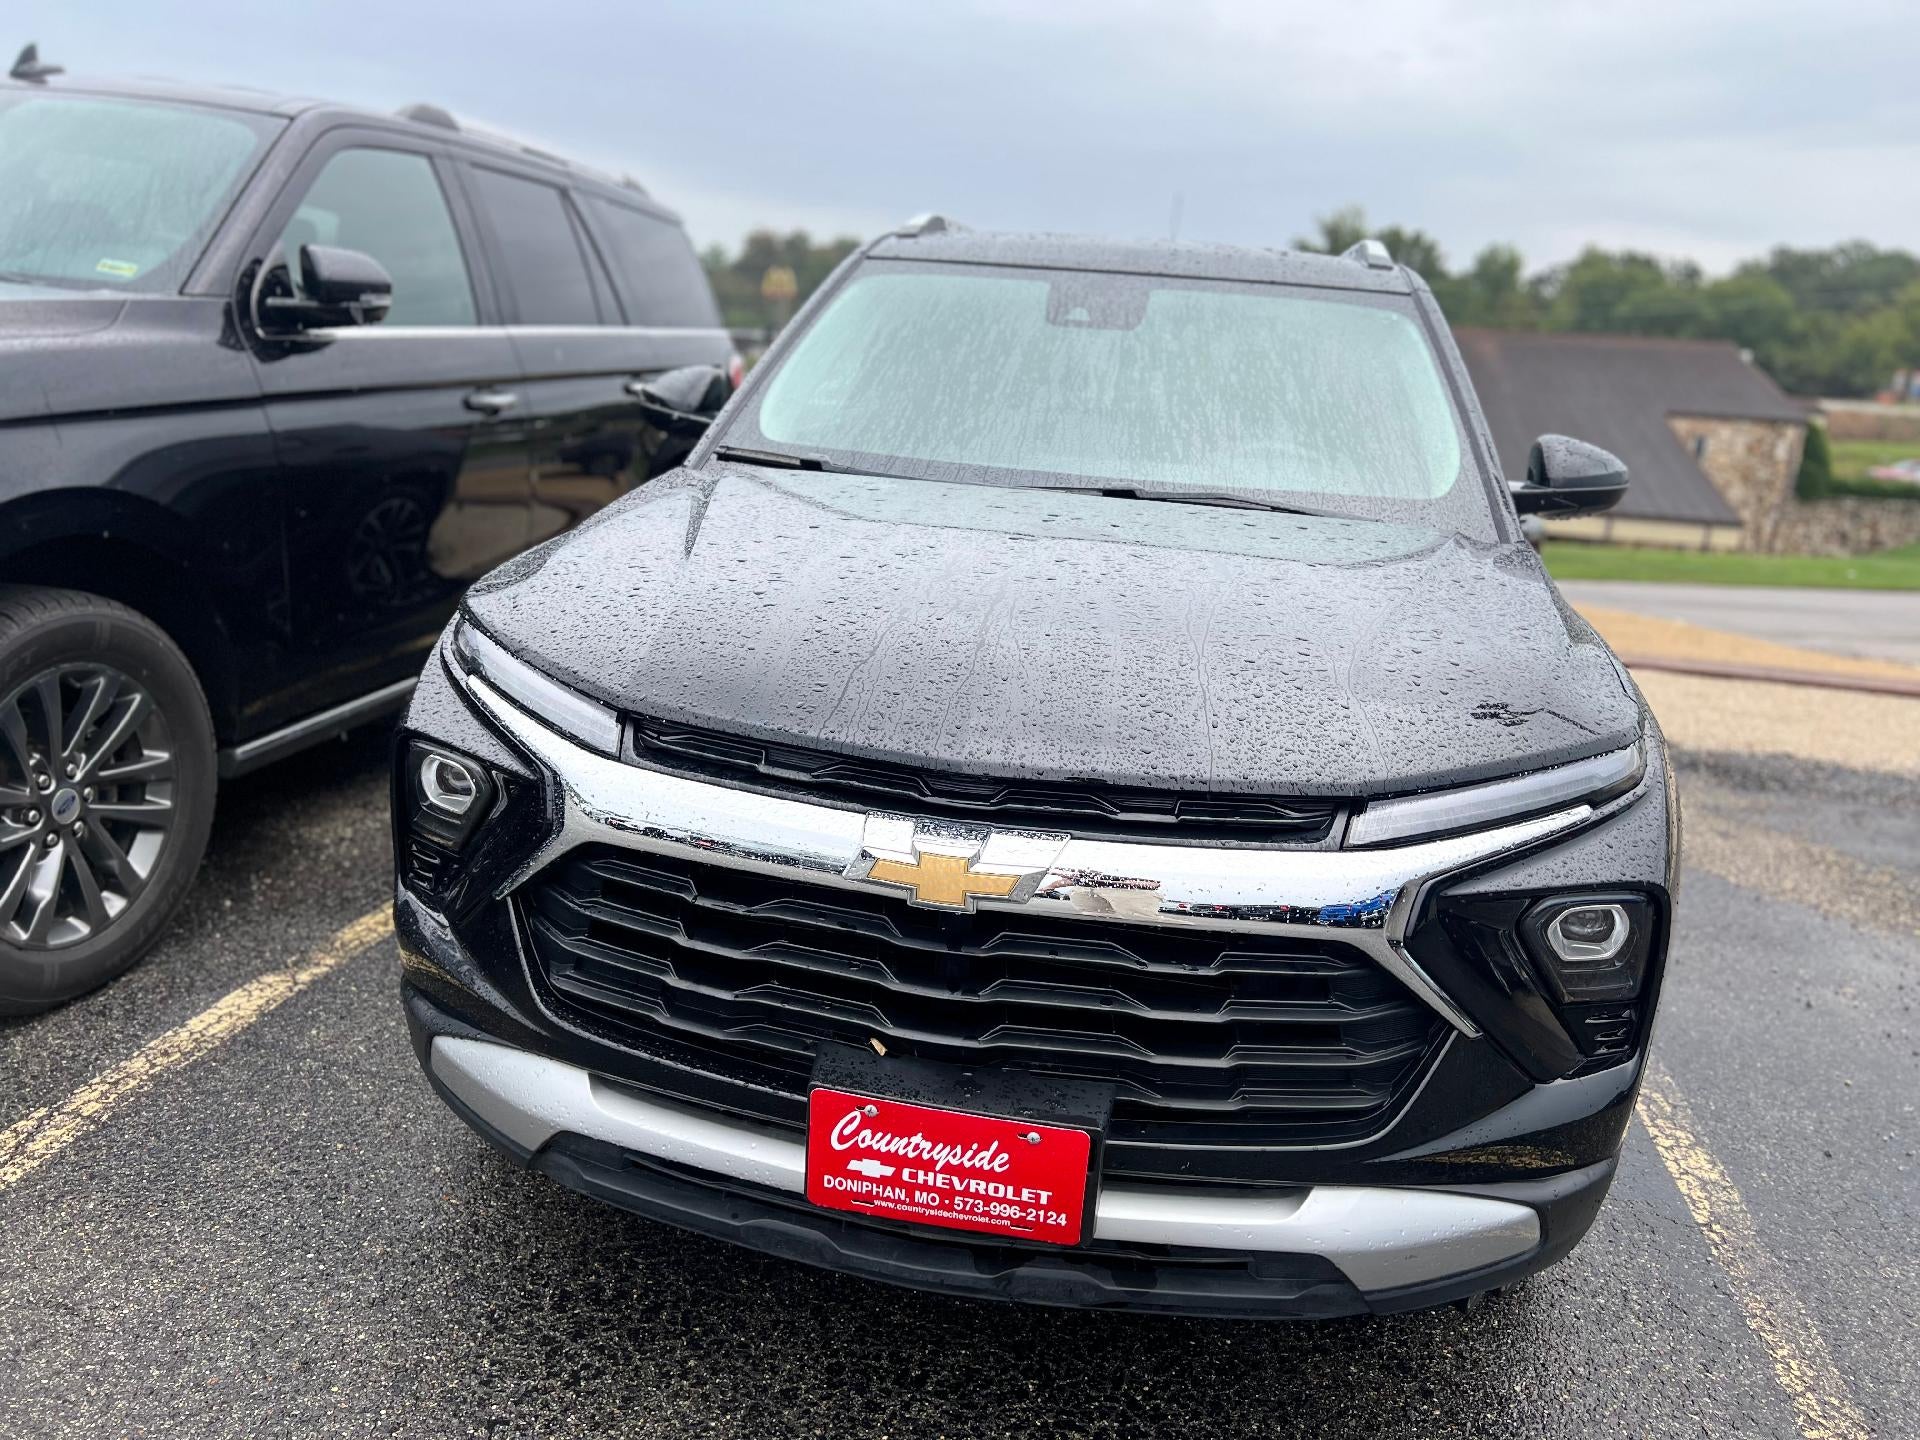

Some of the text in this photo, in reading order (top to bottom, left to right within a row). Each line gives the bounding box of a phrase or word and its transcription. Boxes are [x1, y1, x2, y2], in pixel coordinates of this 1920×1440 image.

[830, 1110, 1011, 1173] Countryside
[823, 1174, 1067, 1227] DONIPHAN, MO 573-996-2124
[901, 1167, 1053, 1205] CHEVROLET
[874, 1199, 1011, 1227] www.countrysidechevrolet.com
